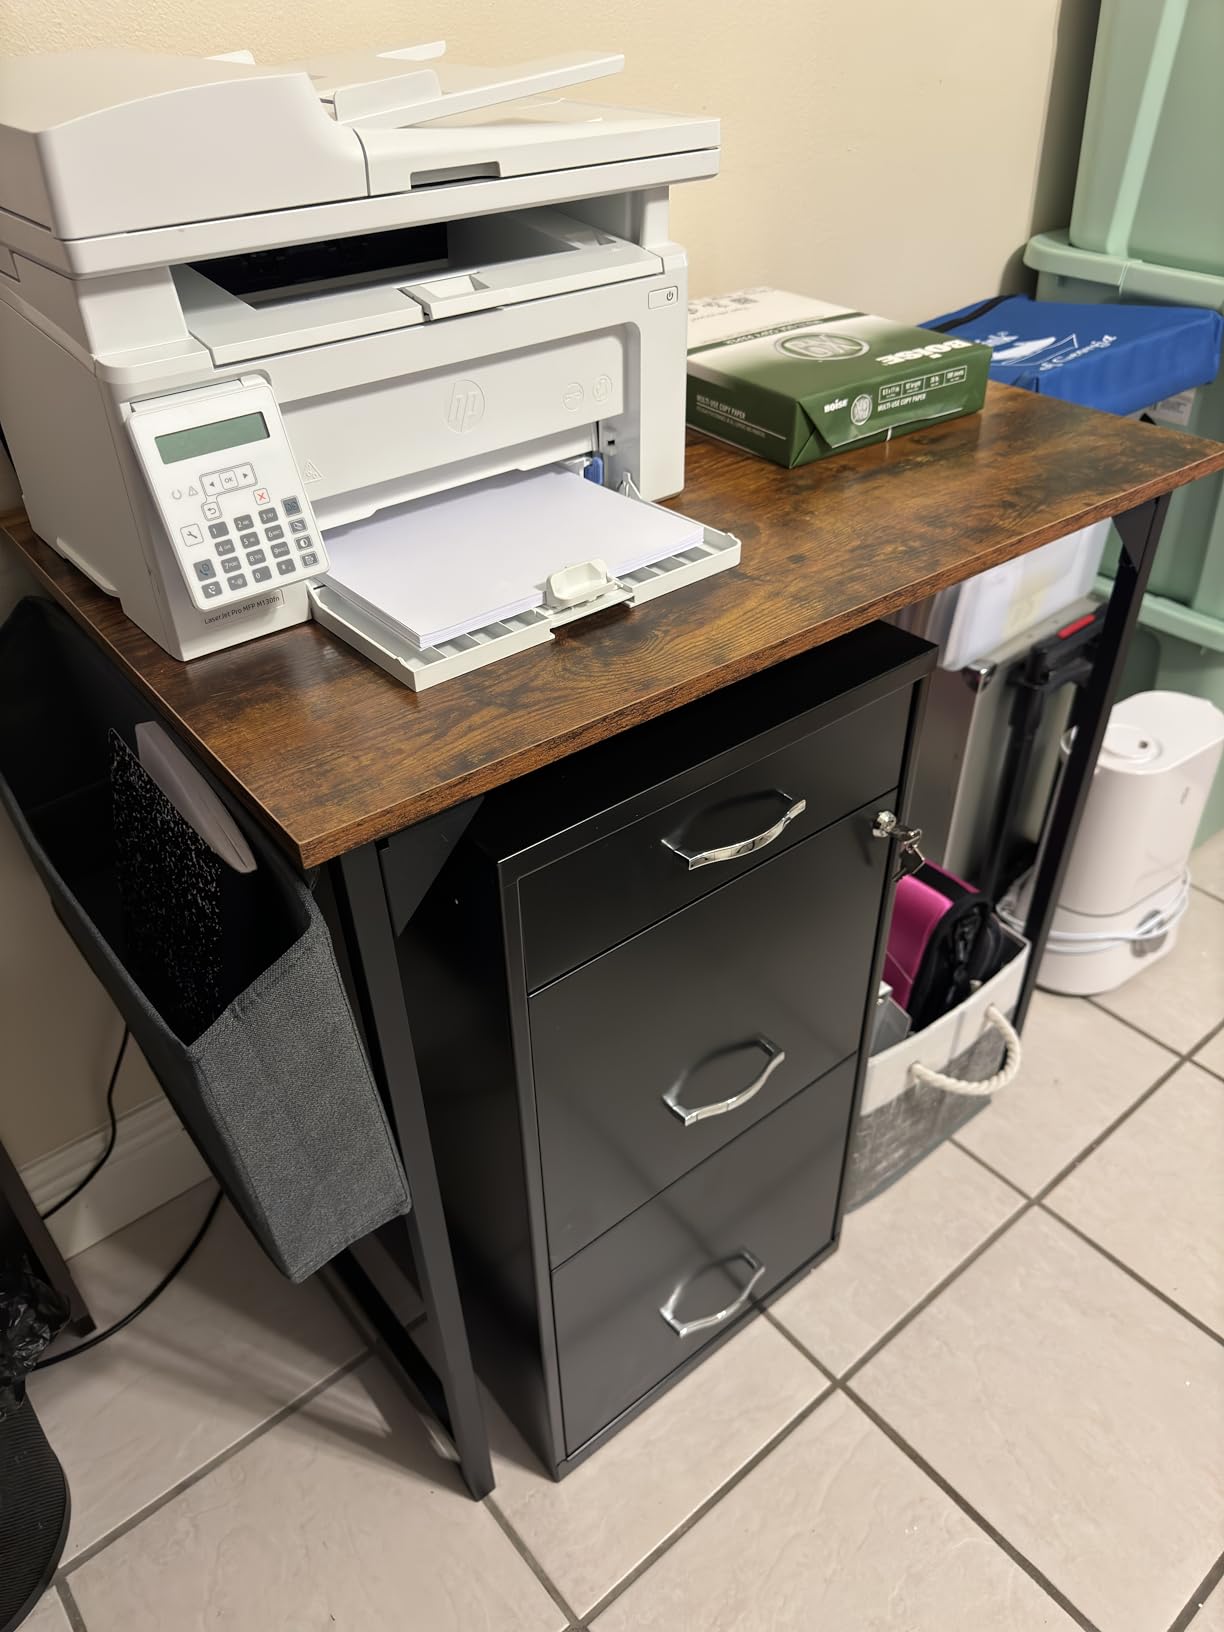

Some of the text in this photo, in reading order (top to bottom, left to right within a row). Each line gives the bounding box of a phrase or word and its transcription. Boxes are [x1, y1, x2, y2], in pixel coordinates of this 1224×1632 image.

[900, 397, 912, 406] COPY
[912, 393, 927, 402] PAPER
[204, 595, 280, 625] LaserJet Pro MFP M130fn
